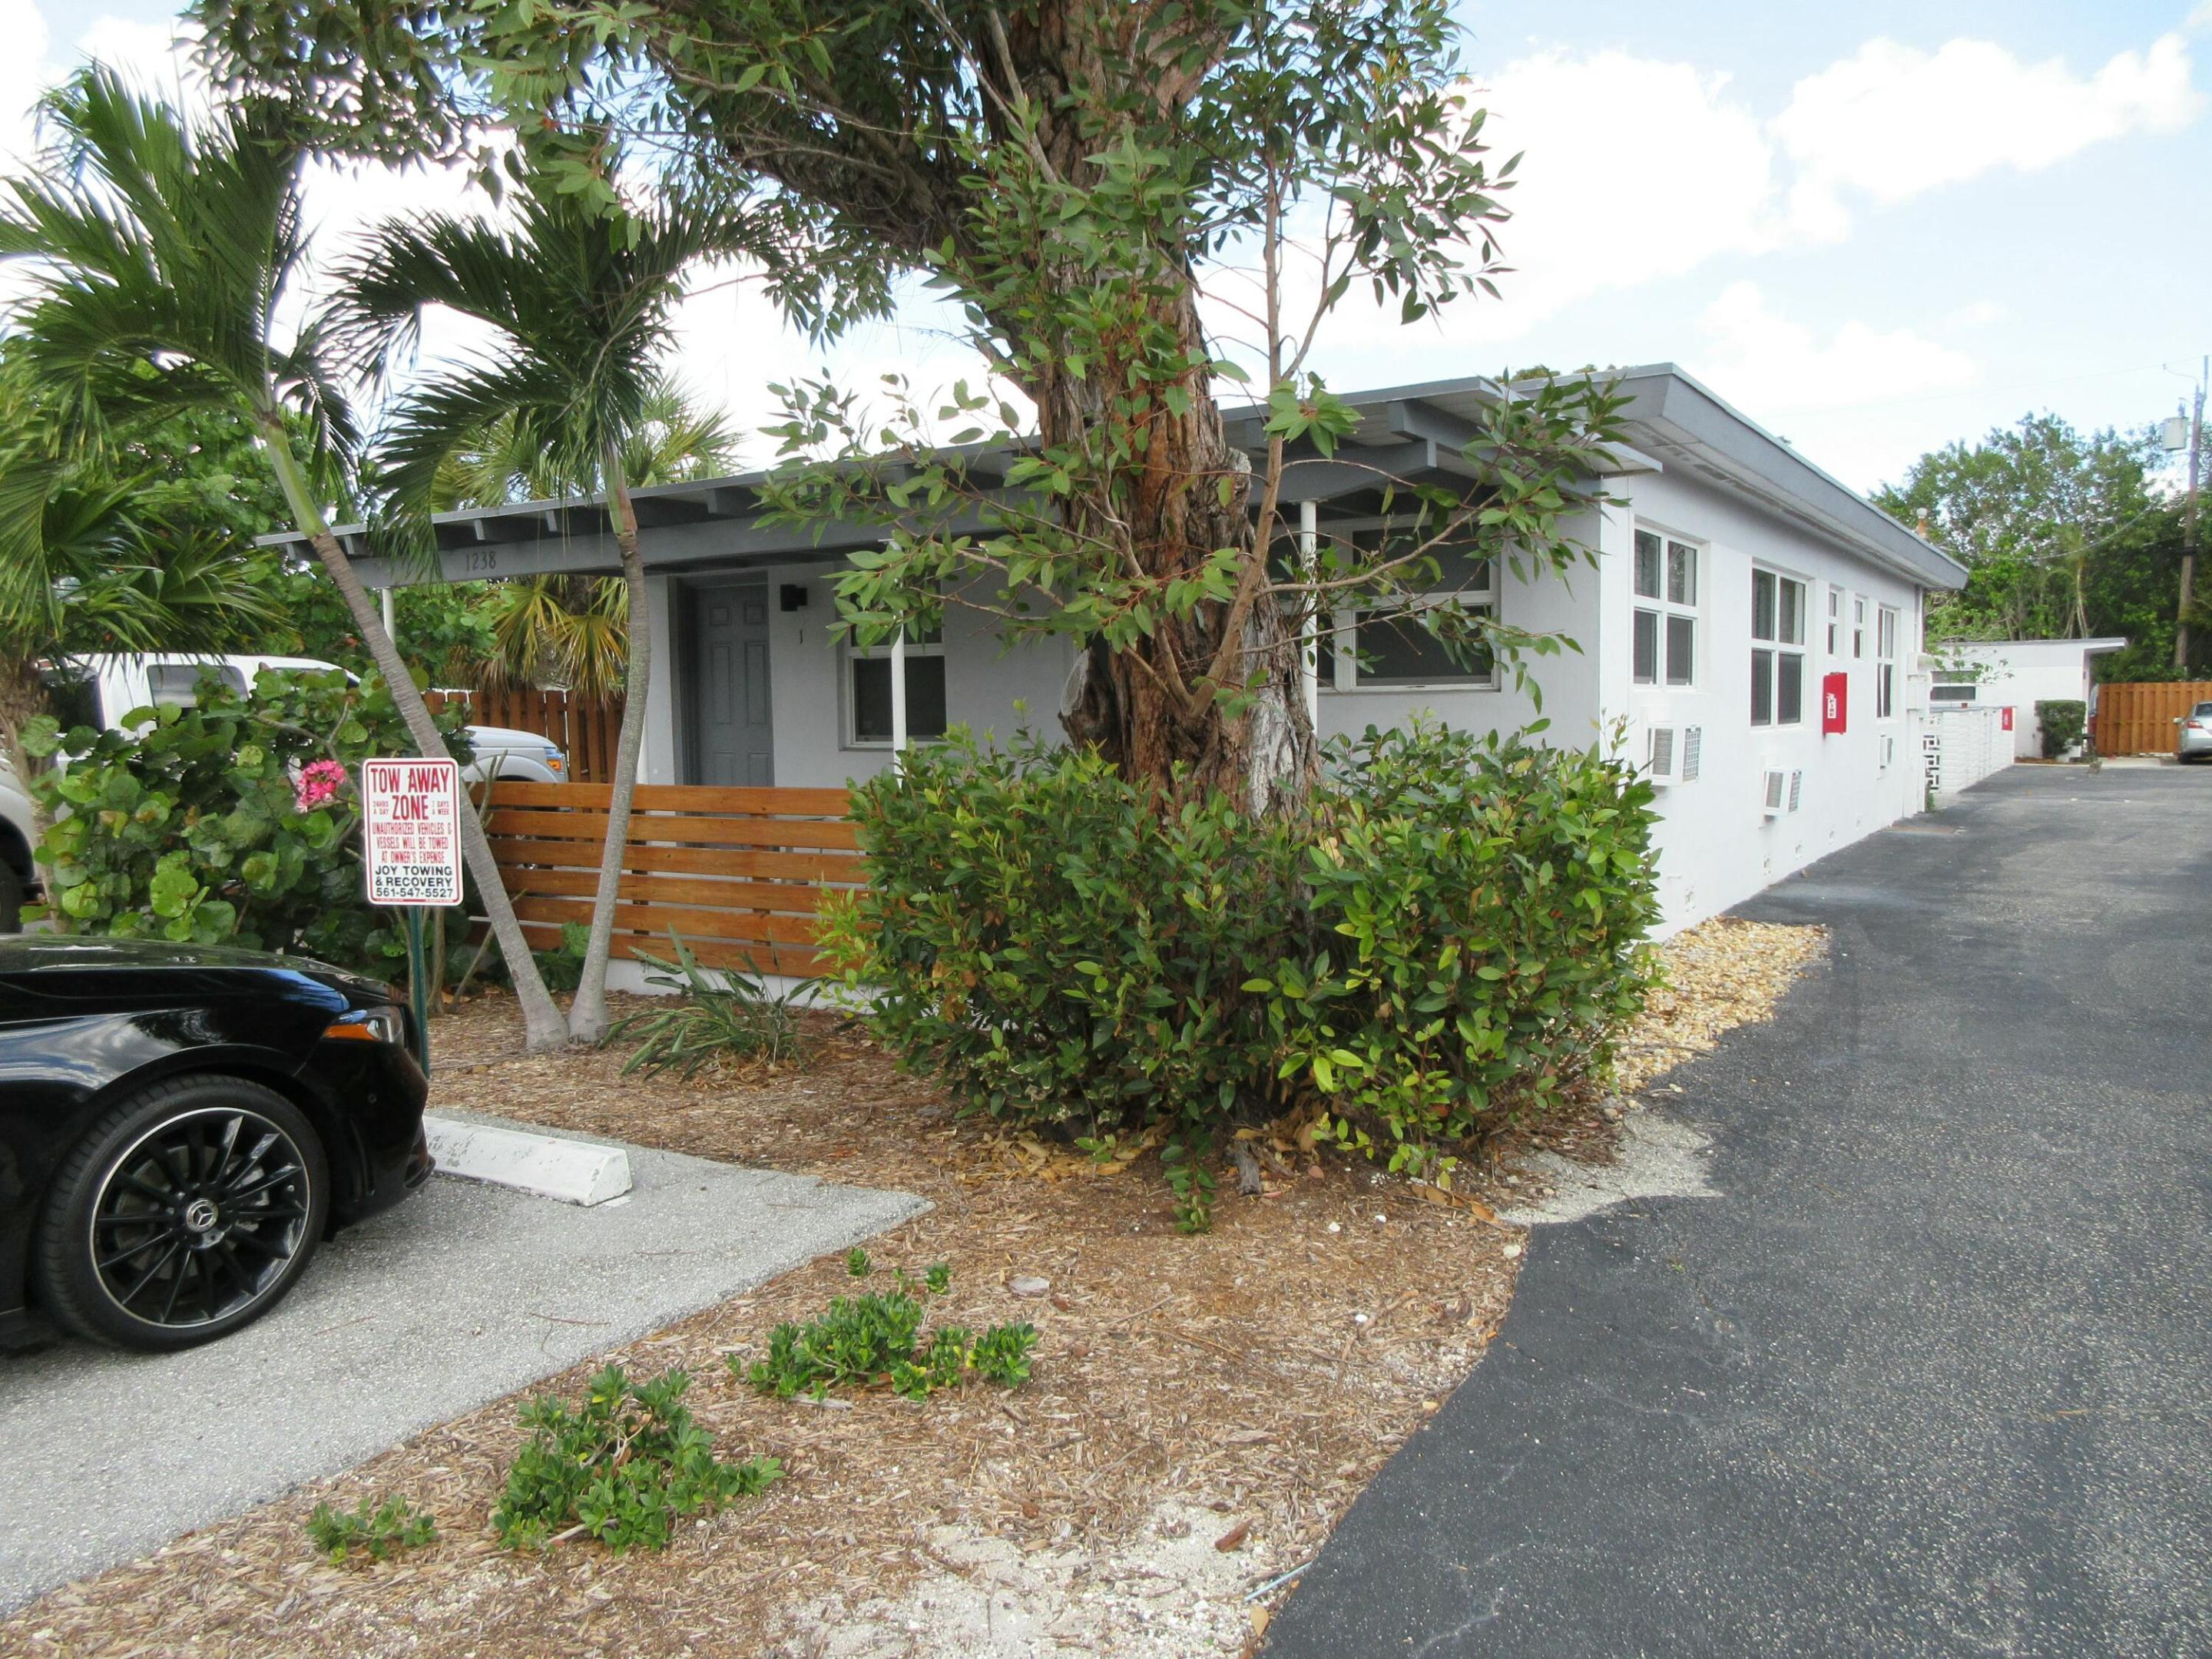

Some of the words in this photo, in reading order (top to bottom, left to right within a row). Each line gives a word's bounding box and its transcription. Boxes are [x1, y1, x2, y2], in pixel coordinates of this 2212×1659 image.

[466, 551, 496, 571] 1238
[371, 768, 400, 793] TOW
[408, 767, 449, 793] AWAY
[392, 795, 429, 820] ZONE
[373, 823, 414, 835] UNAUTHORIZED
[418, 823, 444, 834] VEHICLES
[376, 837, 399, 849] VESSELS
[402, 837, 416, 849] WILL
[419, 837, 426, 849] BE
[429, 837, 449, 849] TOWED
[382, 851, 387, 863] AT
[391, 852, 416, 863] OWNER'S
[419, 852, 445, 863] EXPENSE
[376, 866, 397, 875] JOY
[402, 866, 452, 876] TOWING
[376, 876, 382, 886] &
[386, 877, 452, 886] RECOVERY
[376, 888, 452, 897] 561-547-5527
